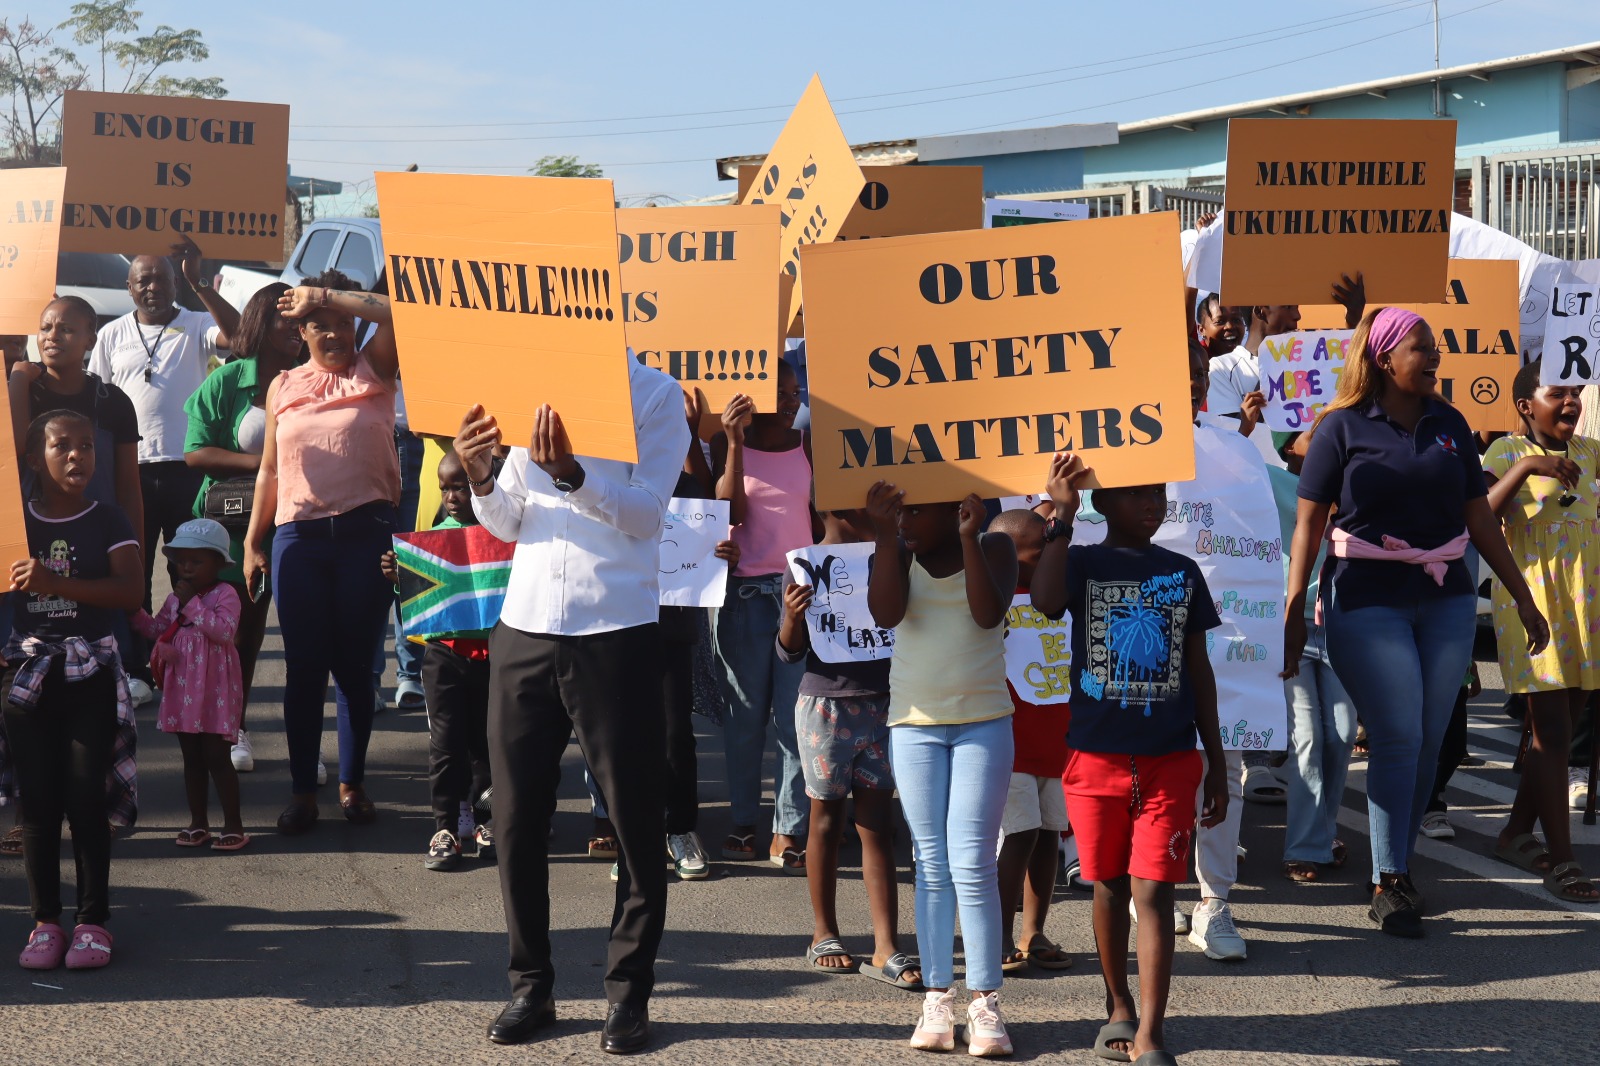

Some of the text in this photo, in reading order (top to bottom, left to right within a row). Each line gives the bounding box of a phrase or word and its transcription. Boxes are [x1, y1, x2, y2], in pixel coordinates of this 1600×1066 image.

[92, 111, 256, 145] ENOUGH
[154, 161, 192, 187] IS
[1255, 161, 1427, 187] MAKUPHELE
[8, 199, 54, 223] AM
[62, 203, 278, 238] ENOUGH!!!!!
[1226, 209, 1449, 235] UKUHLUKUMEZA
[389, 254, 614, 322] KWANELE!!!!!
[919, 254, 1060, 305] OUR
[1552, 287, 1592, 317] LET
[867, 327, 1122, 389] SAFETY
[1266, 337, 1303, 362] WE
[1267, 369, 1322, 401] MORE
[838, 402, 1163, 469] MATTERS
[794, 555, 853, 595] WE
[808, 604, 845, 633] THE
[1038, 632, 1071, 664] BE
